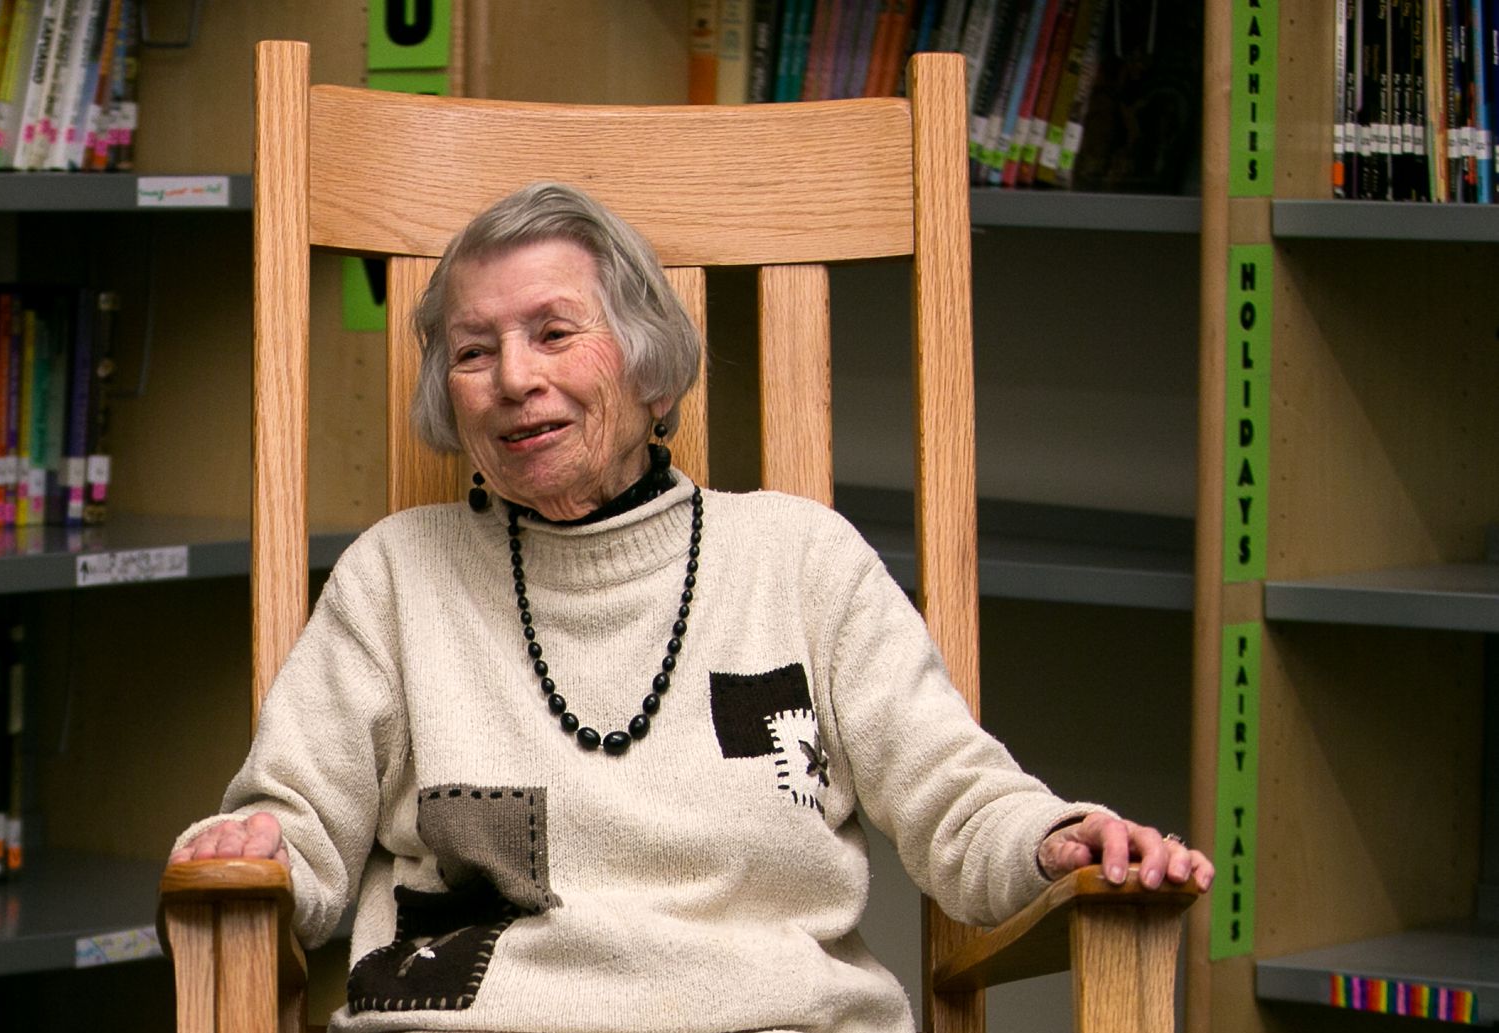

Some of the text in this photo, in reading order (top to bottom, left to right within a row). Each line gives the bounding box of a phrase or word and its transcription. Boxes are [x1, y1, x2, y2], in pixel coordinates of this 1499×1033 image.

[1237, 263, 1256, 565] HOLIDAYS
[1230, 636, 1248, 943] FAIRY TALES
